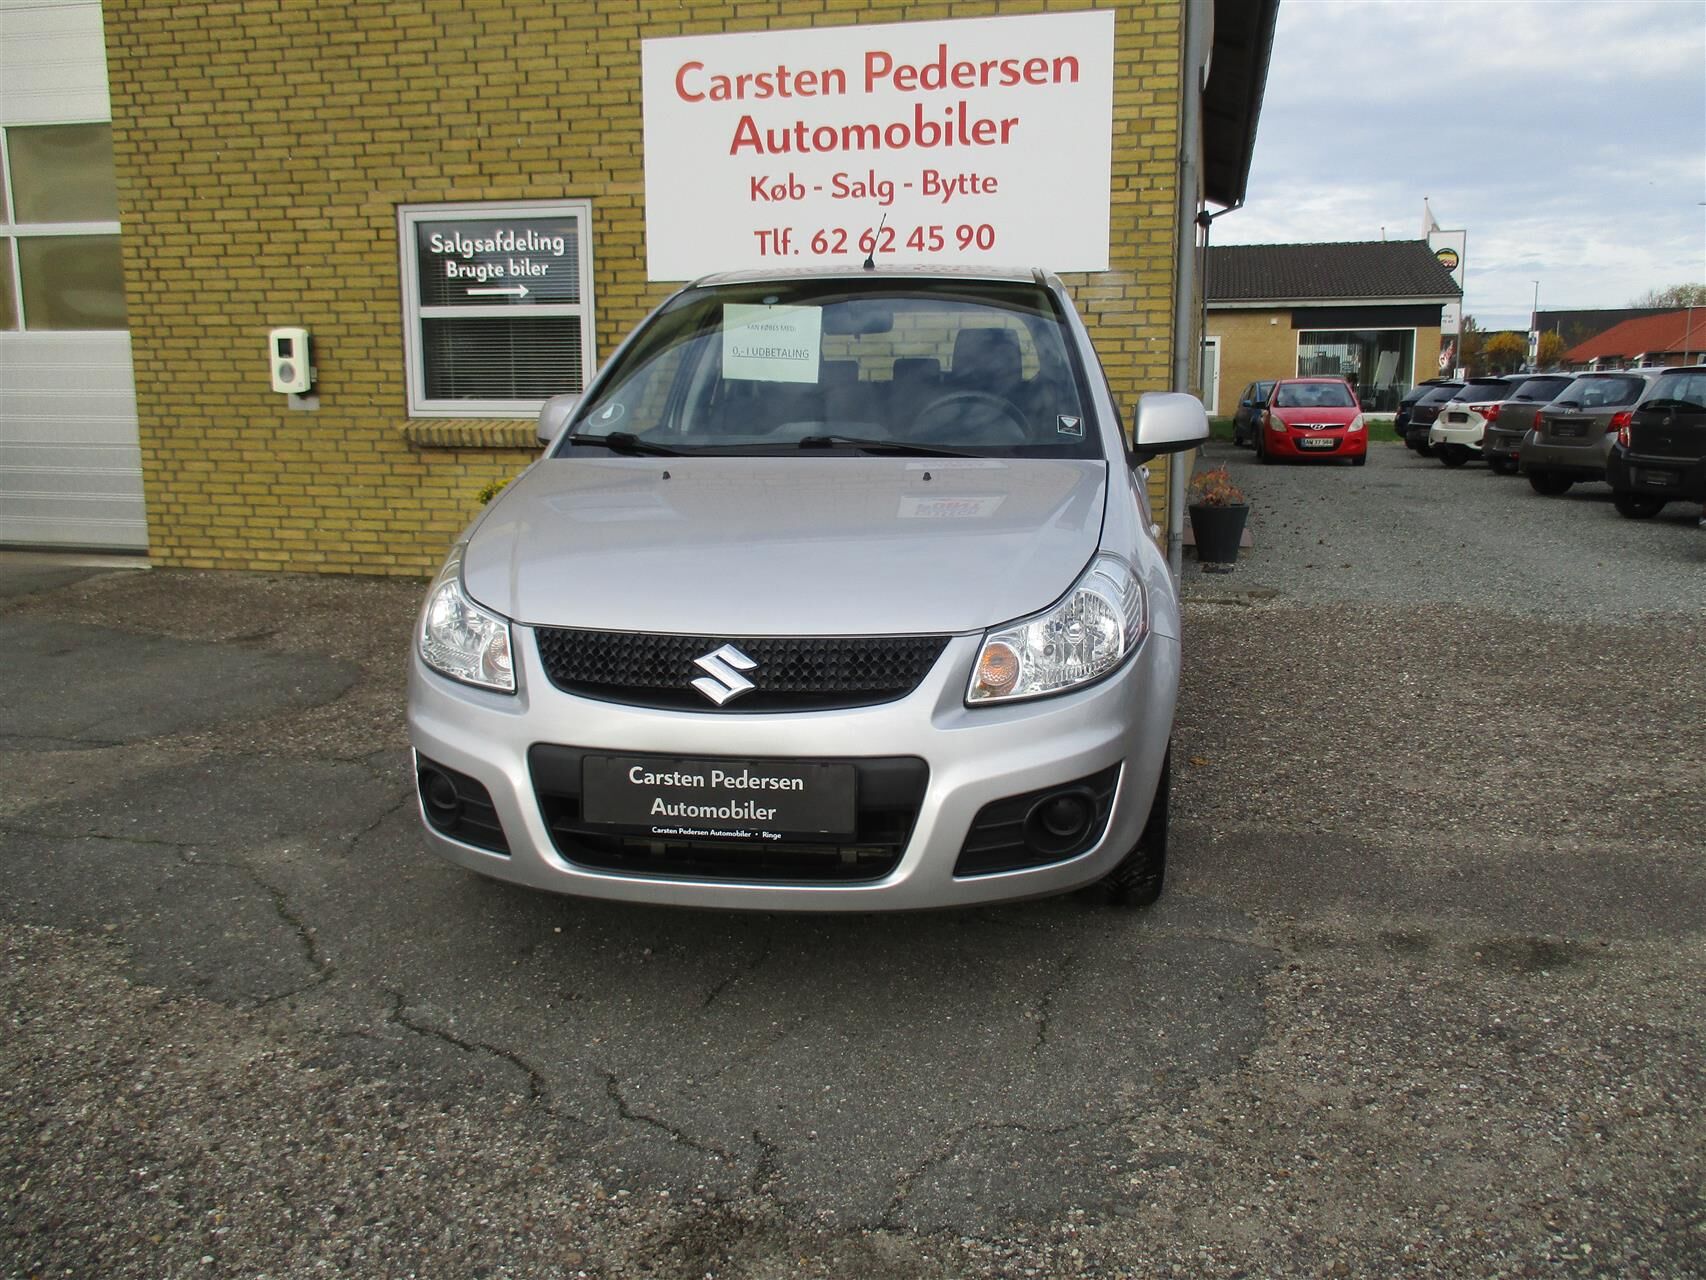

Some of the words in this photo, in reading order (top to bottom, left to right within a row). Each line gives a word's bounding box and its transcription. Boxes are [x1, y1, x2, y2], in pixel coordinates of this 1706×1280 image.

[675, 61, 847, 102] Carsten
[864, 43, 1080, 93] Pedersen
[729, 101, 1020, 156] Automobiler
[750, 173, 806, 203] Køb
[831, 169, 896, 207] Salg
[922, 169, 999, 203] Bytte
[431, 229, 565, 258] Salgsafdeling
[753, 228, 800, 256] Tlf.
[811, 227, 848, 255] 62
[858, 227, 896, 255] 62
[906, 225, 945, 252] 45
[955, 223, 997, 251] 90
[446, 261, 504, 282] Brugte
[509, 257, 549, 277] biler
[751, 347, 810, 359] UDBETALING
[628, 765, 705, 788] Carsten
[711, 769, 804, 791] Pedersen
[650, 797, 777, 820] Automobiler
[651, 826, 678, 835] Carsten
[679, 827, 709, 836] Pedersen
[710, 829, 752, 838] Automobiler
[762, 831, 782, 841] Ringe
